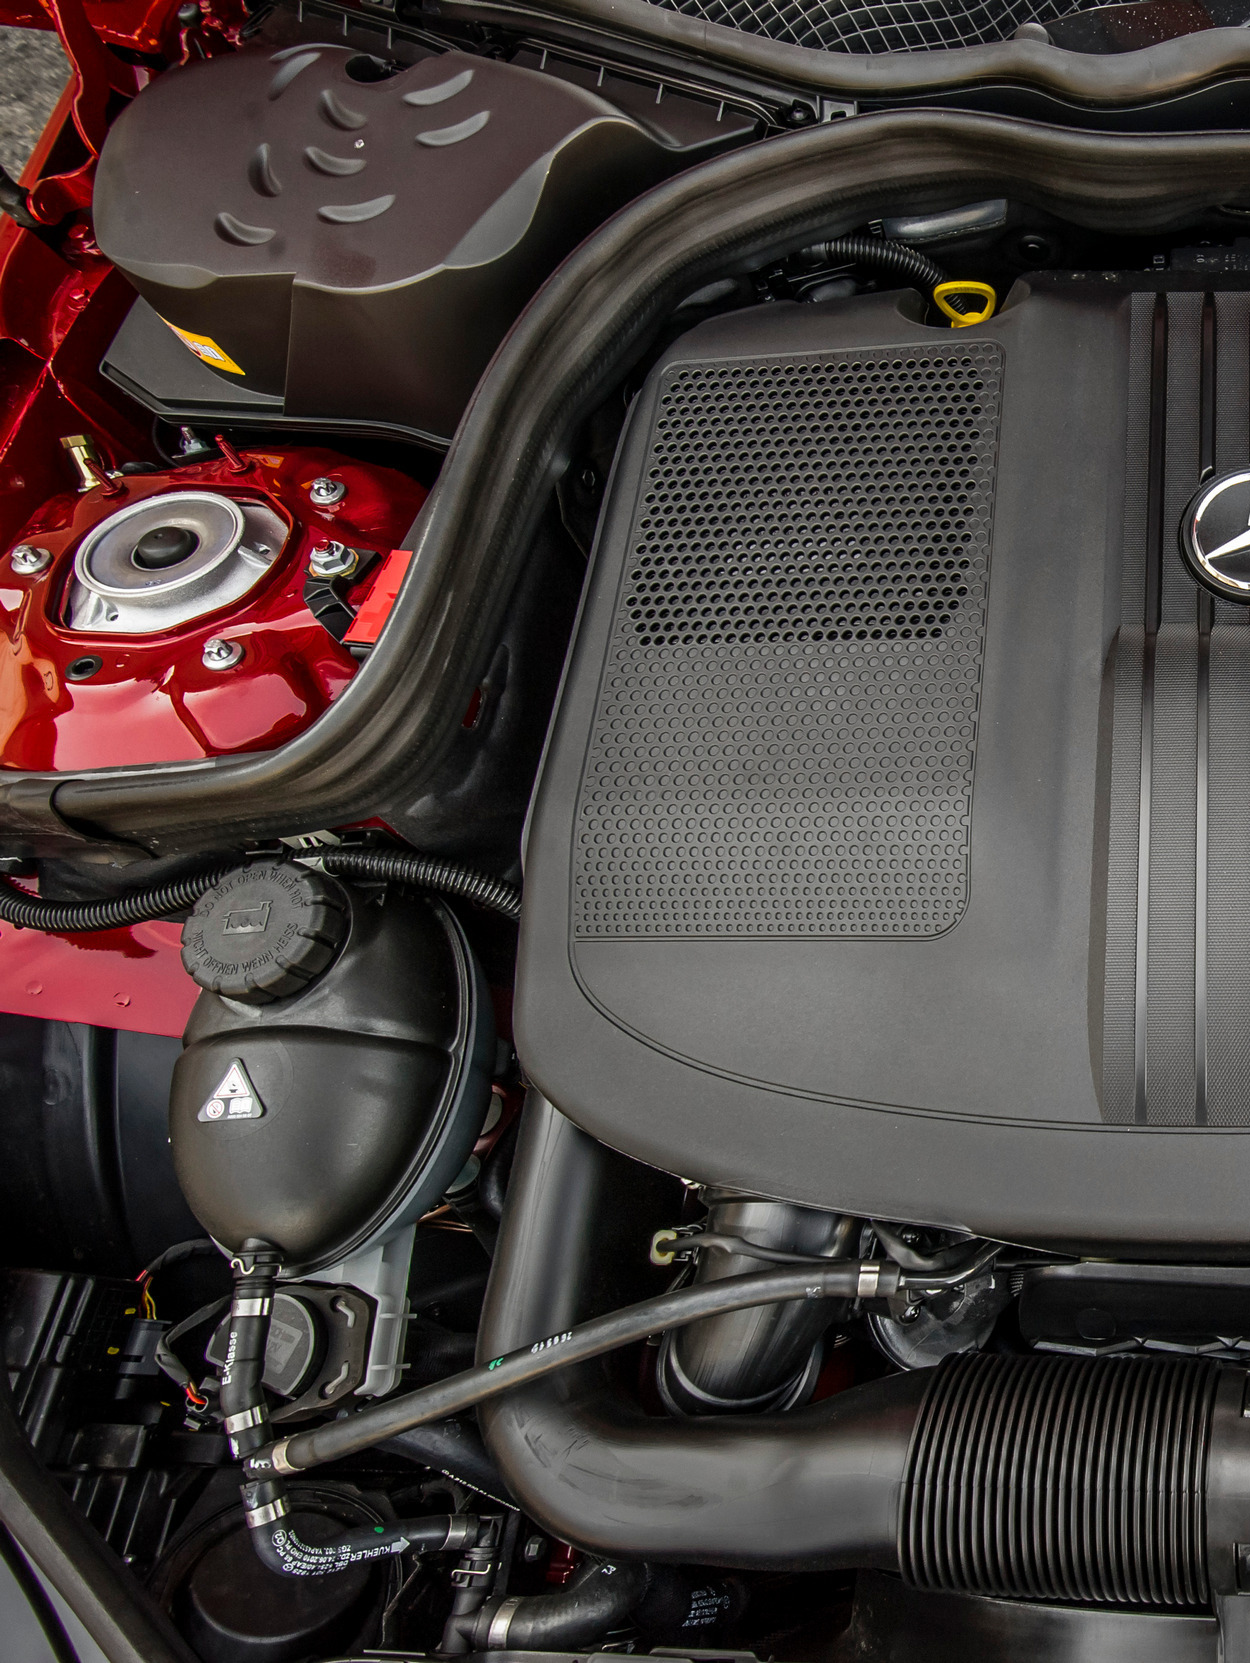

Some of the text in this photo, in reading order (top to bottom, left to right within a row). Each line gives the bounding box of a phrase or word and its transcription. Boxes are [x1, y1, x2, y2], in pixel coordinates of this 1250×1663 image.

[200, 870, 305, 918] DO NOT OPEN WHEN HOT
[192, 930, 209, 960] NICHT
[242, 950, 274, 973] WENN
[273, 922, 299, 954] HEISS
[222, 1331, 238, 1386] E-Klasse
[350, 1545, 392, 1562] KUEHLER
